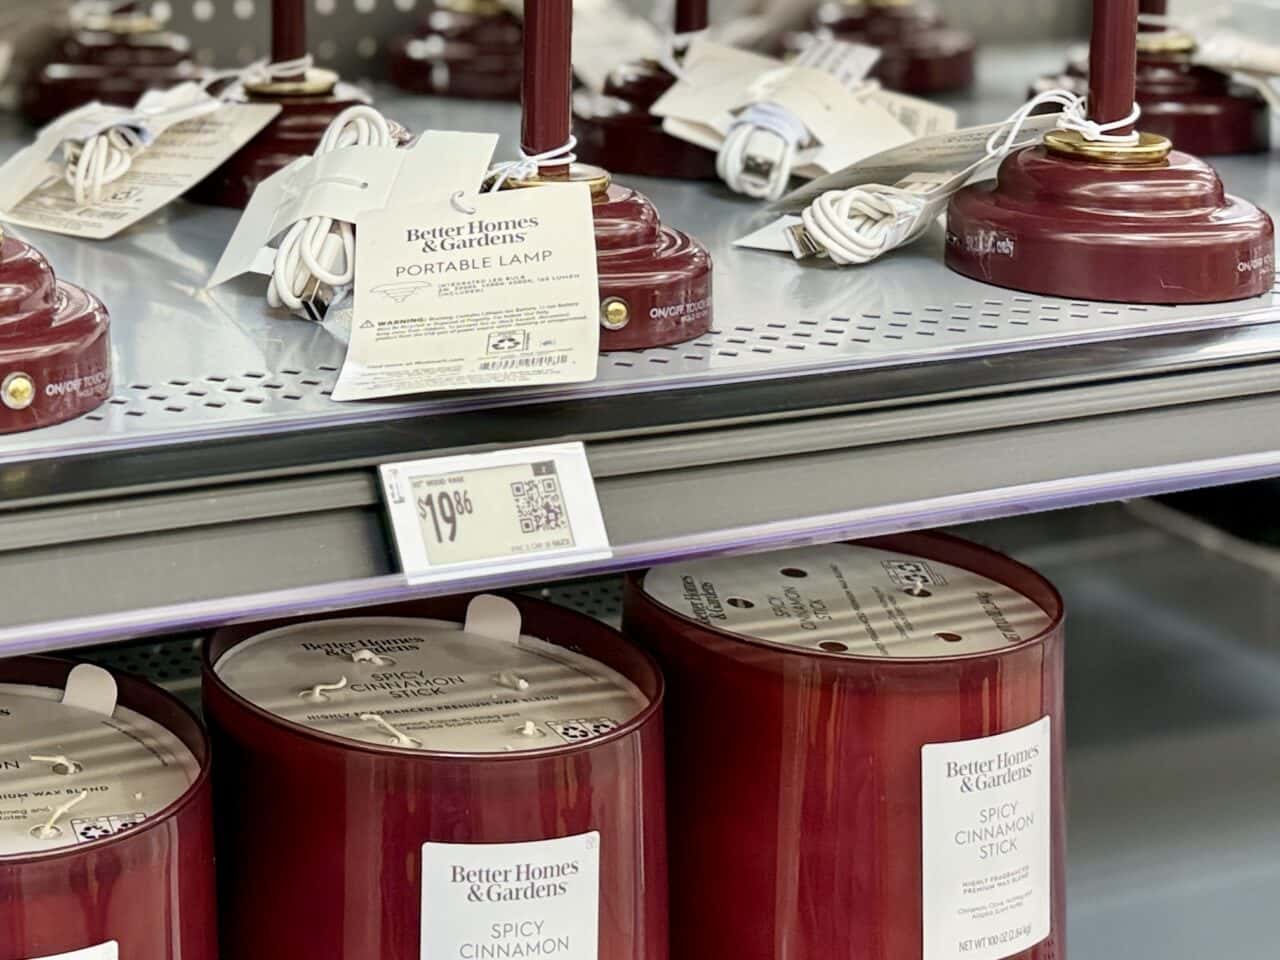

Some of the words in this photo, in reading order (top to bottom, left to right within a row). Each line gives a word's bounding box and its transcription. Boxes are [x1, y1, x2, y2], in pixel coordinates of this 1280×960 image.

[406, 225, 466, 242] Better
[468, 217, 539, 235] Homes
[395, 257, 492, 278] PORTABLE
[499, 249, 553, 267] LAMP
[302, 640, 356, 652] Better
[357, 636, 425, 648] Homes
[340, 644, 420, 656] Gdens
[350, 676, 465, 692] CINNAMON
[371, 670, 425, 682] SPICY
[389, 687, 447, 699] STICK
[307, 712, 351, 721] HIGHLY
[437, 701, 492, 711] PREMIUM
[946, 759, 995, 778] Better
[996, 744, 1040, 770] Homes
[32, 789, 62, 798] WAX
[979, 801, 1018, 824] SPICY
[954, 812, 1035, 846] CINNAMON
[979, 837, 1018, 860] STICK
[451, 865, 512, 884] Better
[515, 860, 580, 882] Homes
[490, 919, 545, 940] SPICY
[459, 936, 570, 960] CINNAMON
[959, 940, 973, 953] NET
[973, 937, 987, 951] WT
